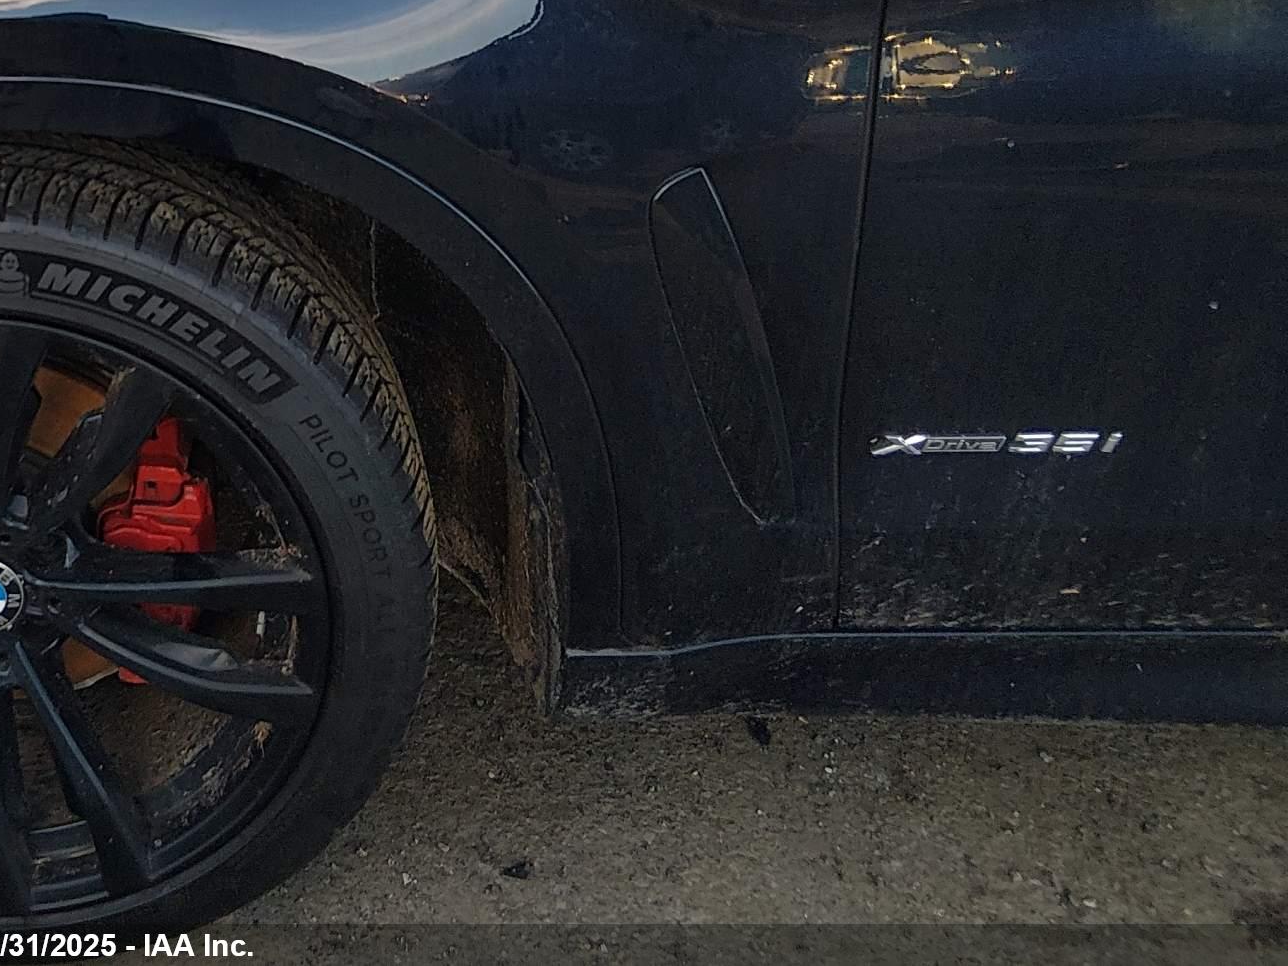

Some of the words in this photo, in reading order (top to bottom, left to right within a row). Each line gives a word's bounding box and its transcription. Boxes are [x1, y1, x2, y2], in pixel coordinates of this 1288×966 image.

[36, 262, 282, 394] MICHELIN
[299, 413, 359, 482] PILOT
[348, 493, 391, 579] SPORT
